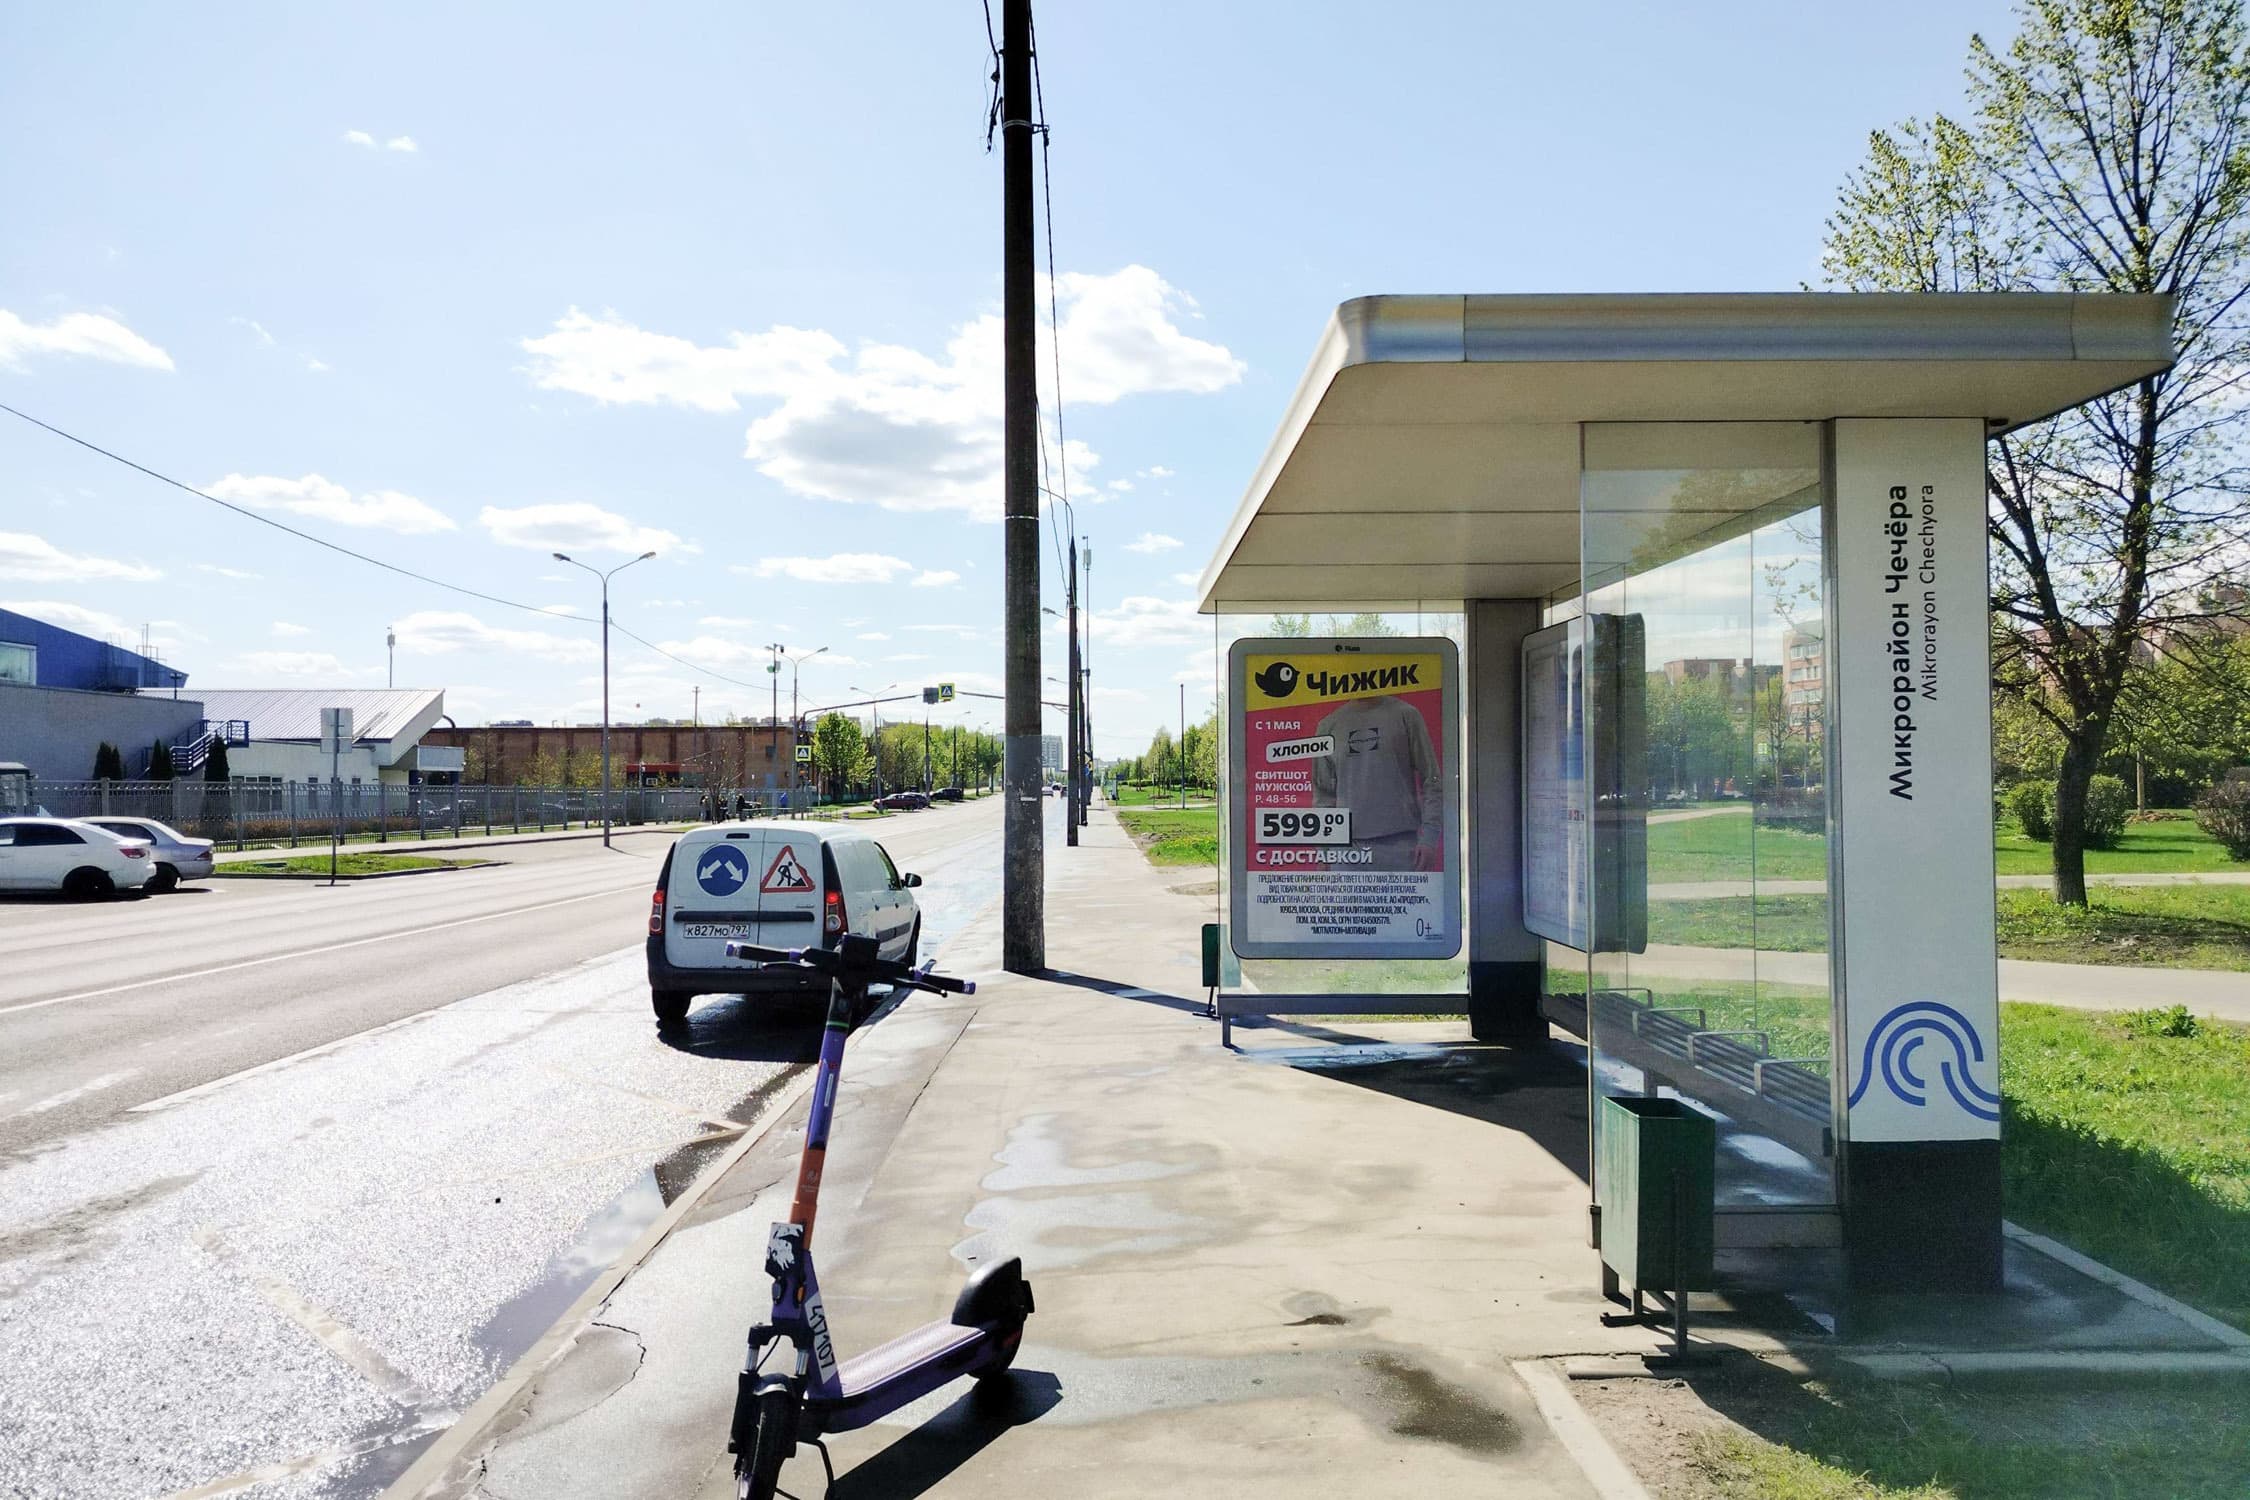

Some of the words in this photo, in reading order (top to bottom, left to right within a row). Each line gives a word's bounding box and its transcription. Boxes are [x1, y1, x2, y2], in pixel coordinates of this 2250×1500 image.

[1884, 484, 1913, 593] Чечёра
[1917, 484, 1938, 584] Chechyora
[1920, 590, 1940, 701] Mikrorayon
[1886, 602, 1917, 801] Микрорайон
[1255, 721, 1263, 730] С
[1265, 721, 1271, 730] 1
[1273, 721, 1301, 730] МАЯ
[1272, 740, 1330, 758] ХЛОПОК
[1255, 771, 1309, 780] СВИТШОТ
[1255, 780, 1312, 792] МУЖСКОЙ
[1266, 794, 1297, 804] 48-56
[1263, 813, 1321, 837] 599
[1255, 850, 1267, 863] С
[1270, 847, 1373, 865] ДОСТАВКОЙ
